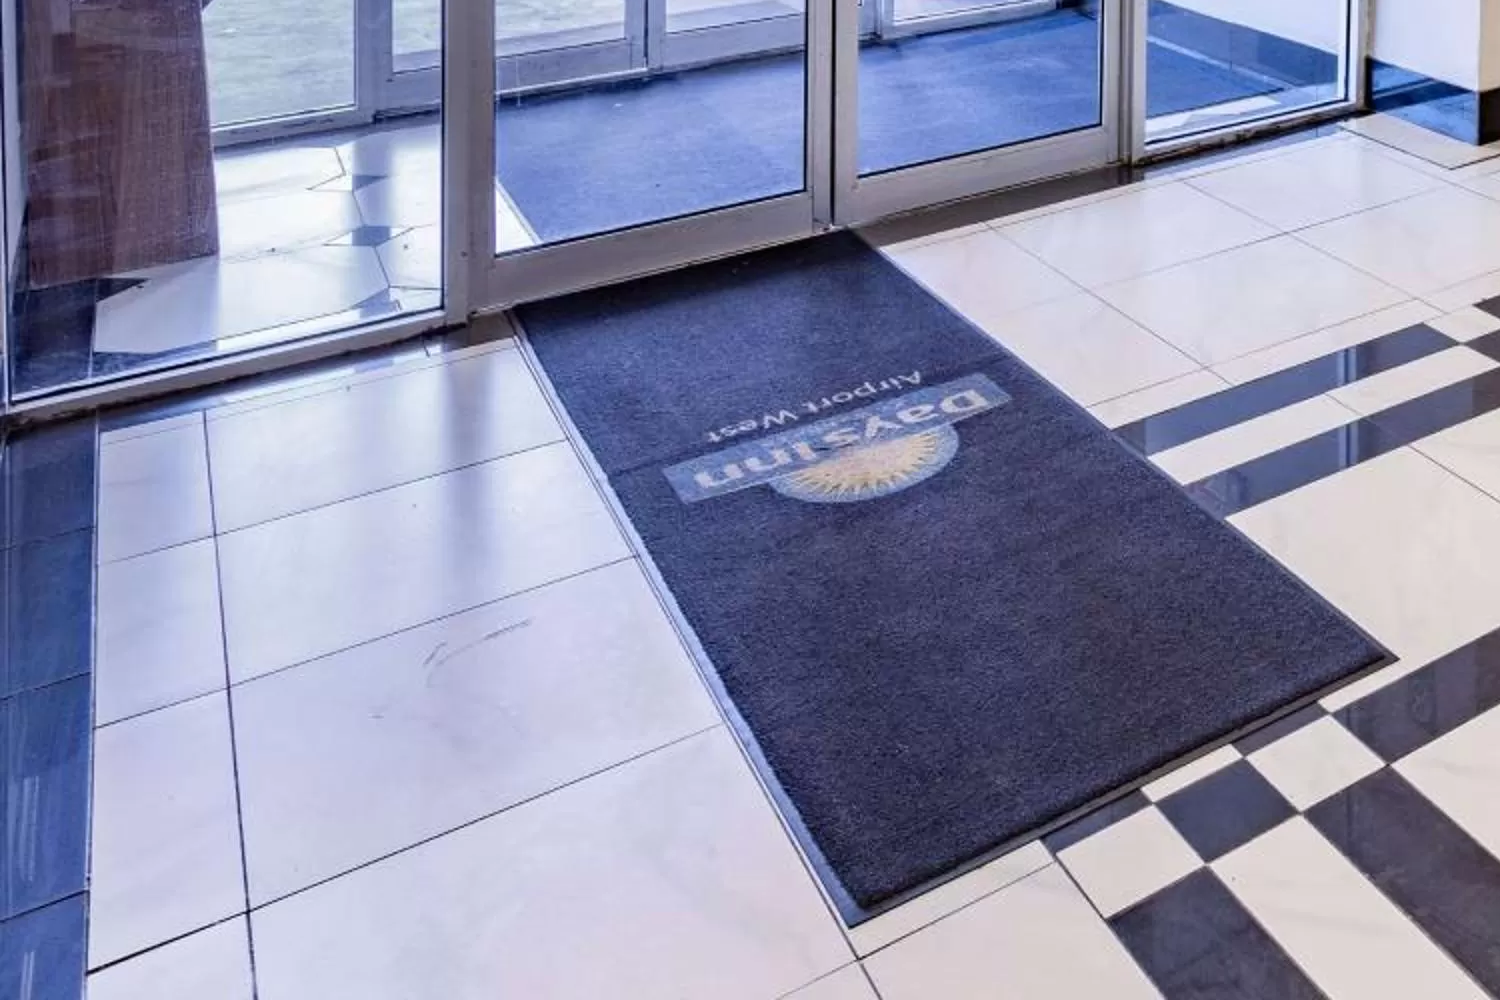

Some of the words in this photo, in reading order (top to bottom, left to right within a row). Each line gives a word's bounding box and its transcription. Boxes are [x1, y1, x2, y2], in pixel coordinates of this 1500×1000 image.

[801, 370, 921, 412] Airport
[707, 409, 798, 443] West
[823, 389, 988, 447] Days
[693, 441, 817, 488] Inn
